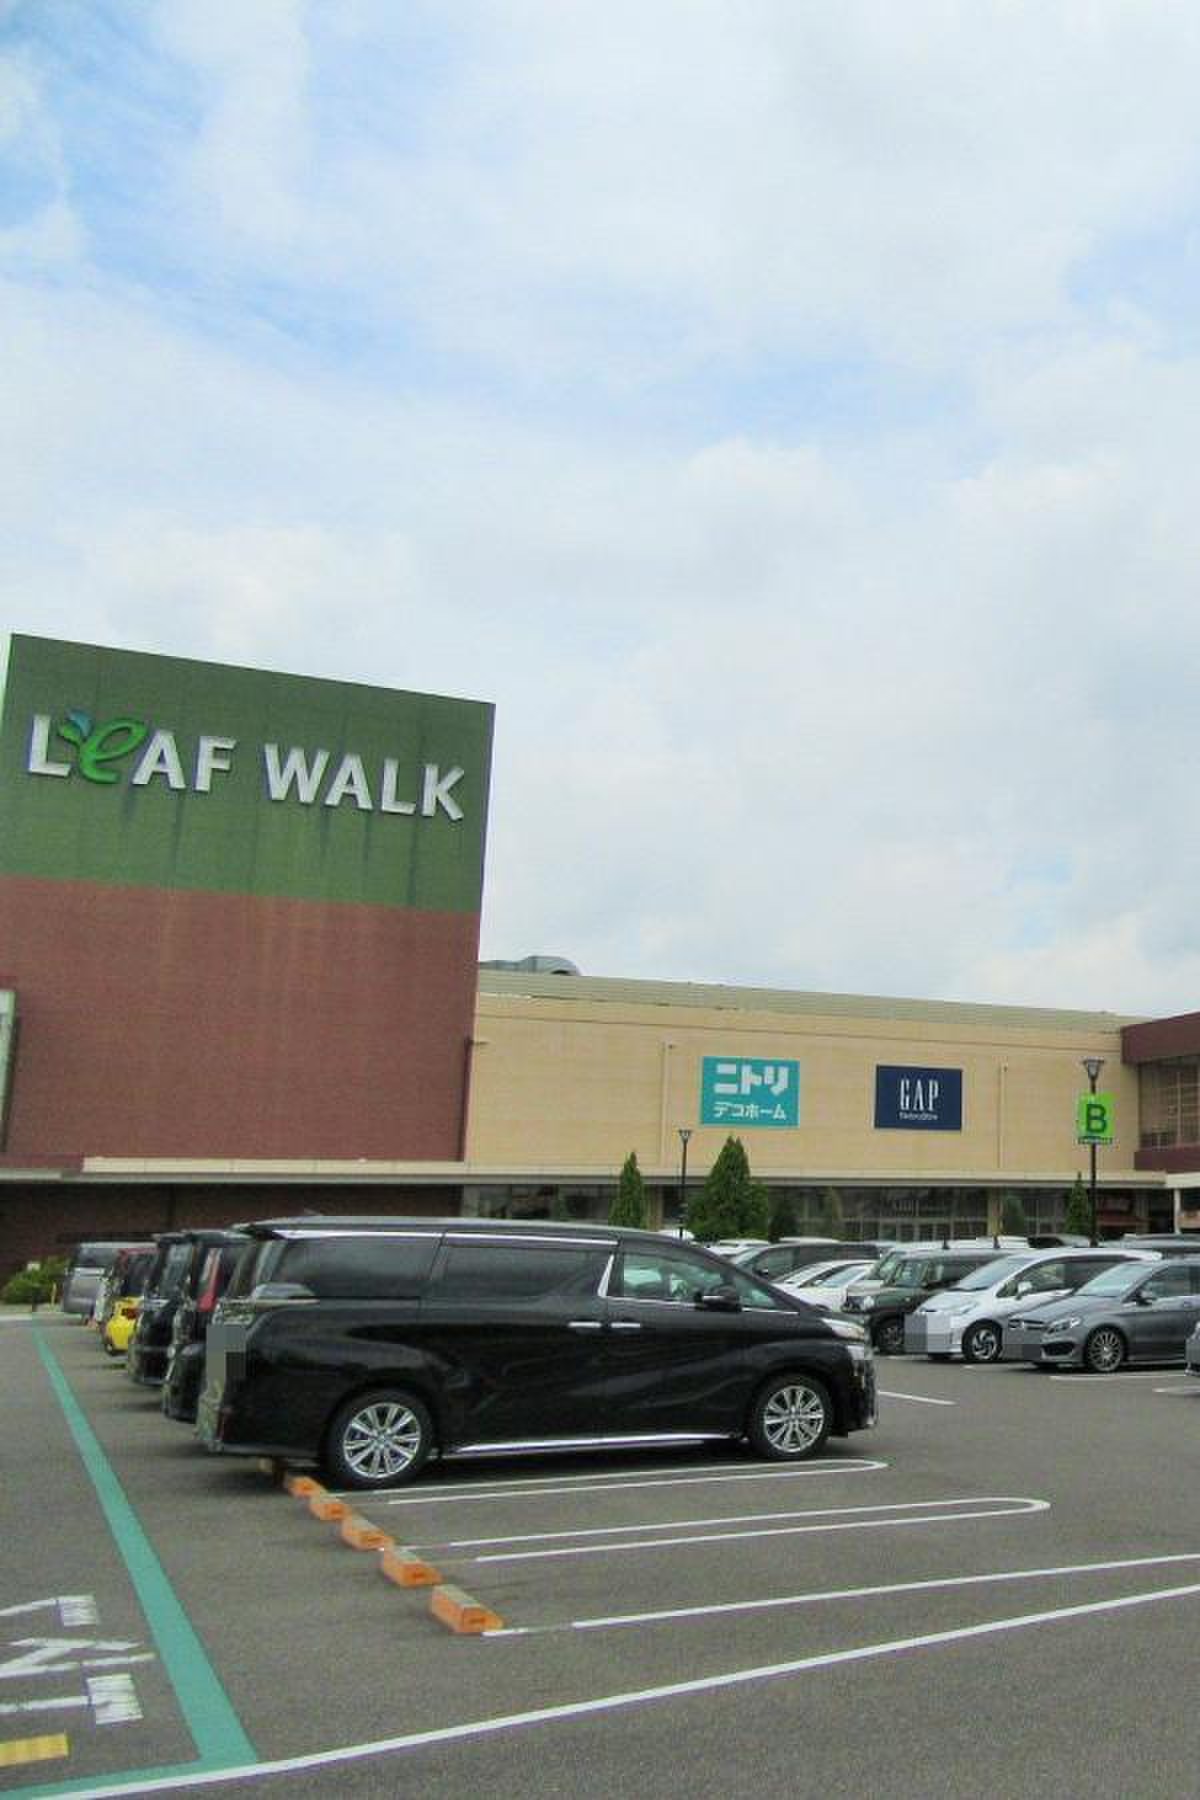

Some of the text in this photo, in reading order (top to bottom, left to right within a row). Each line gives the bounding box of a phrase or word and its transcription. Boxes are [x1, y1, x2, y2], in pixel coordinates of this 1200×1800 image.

[264, 743, 464, 821] WALK
[714, 1063, 789, 1097] ニトリ
[900, 1079, 939, 1112] GAP
[713, 1101, 786, 1121] デコホーム
[1086, 1103, 1107, 1133] B
